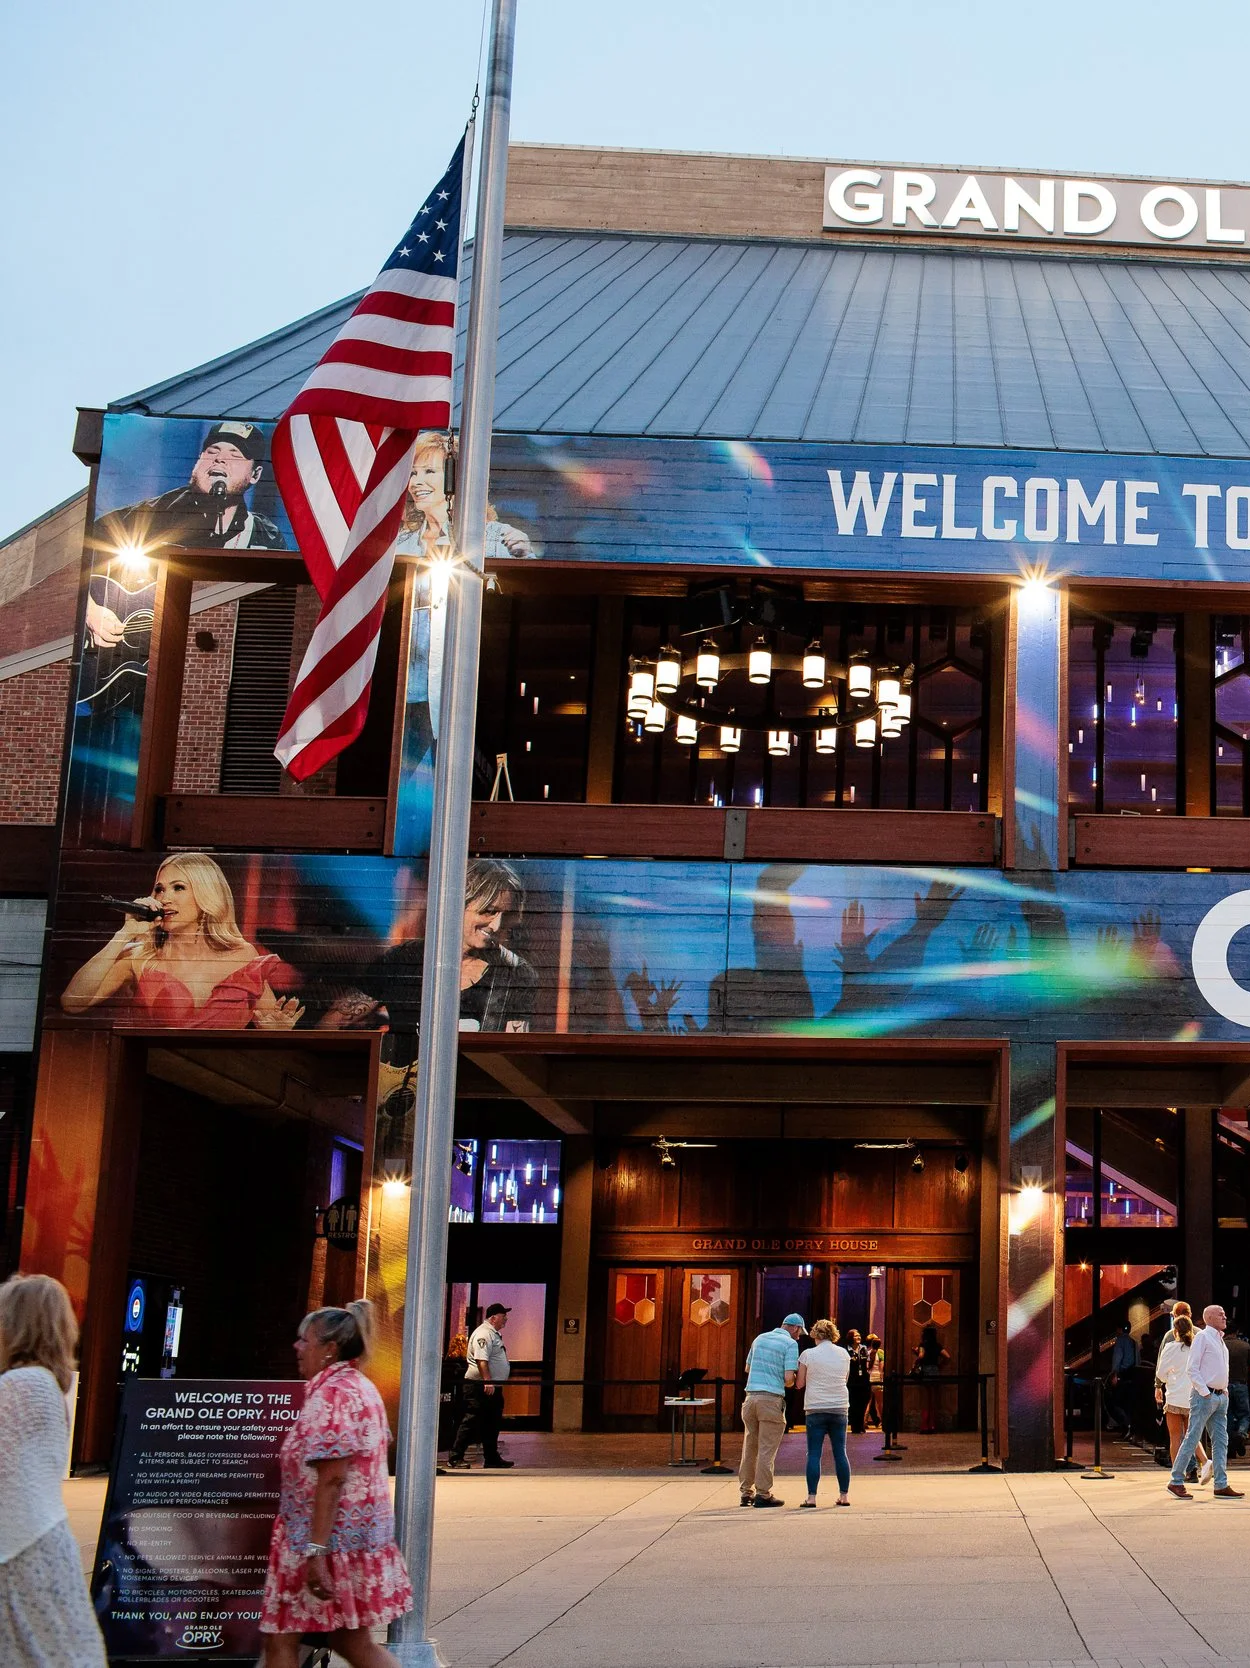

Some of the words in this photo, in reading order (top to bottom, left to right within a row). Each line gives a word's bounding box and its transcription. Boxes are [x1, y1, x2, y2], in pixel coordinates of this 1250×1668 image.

[828, 169, 1117, 236] GRAND
[827, 469, 1160, 546] WELCOME
[692, 1239, 747, 1250] GRAND
[752, 1240, 780, 1250] OLE
[785, 1240, 823, 1250] OPRY
[830, 1240, 878, 1251] HOUSE
[175, 1392, 242, 1404] WELCOME
[246, 1393, 263, 1404] TO
[267, 1394, 291, 1405] THE
[146, 1407, 194, 1419] GRAND
[198, 1408, 224, 1419] OLE
[242, 1424, 266, 1433] safety
[178, 1433, 204, 1441] please
[226, 1433, 238, 1441] the
[240, 1433, 277, 1442] following:
[111, 1612, 145, 1620] THANK
[149, 1612, 172, 1621] YOU,
[175, 1612, 197, 1620] AND
[200, 1612, 234, 1620] ENJOY
[182, 1631, 221, 1644] OPRY
